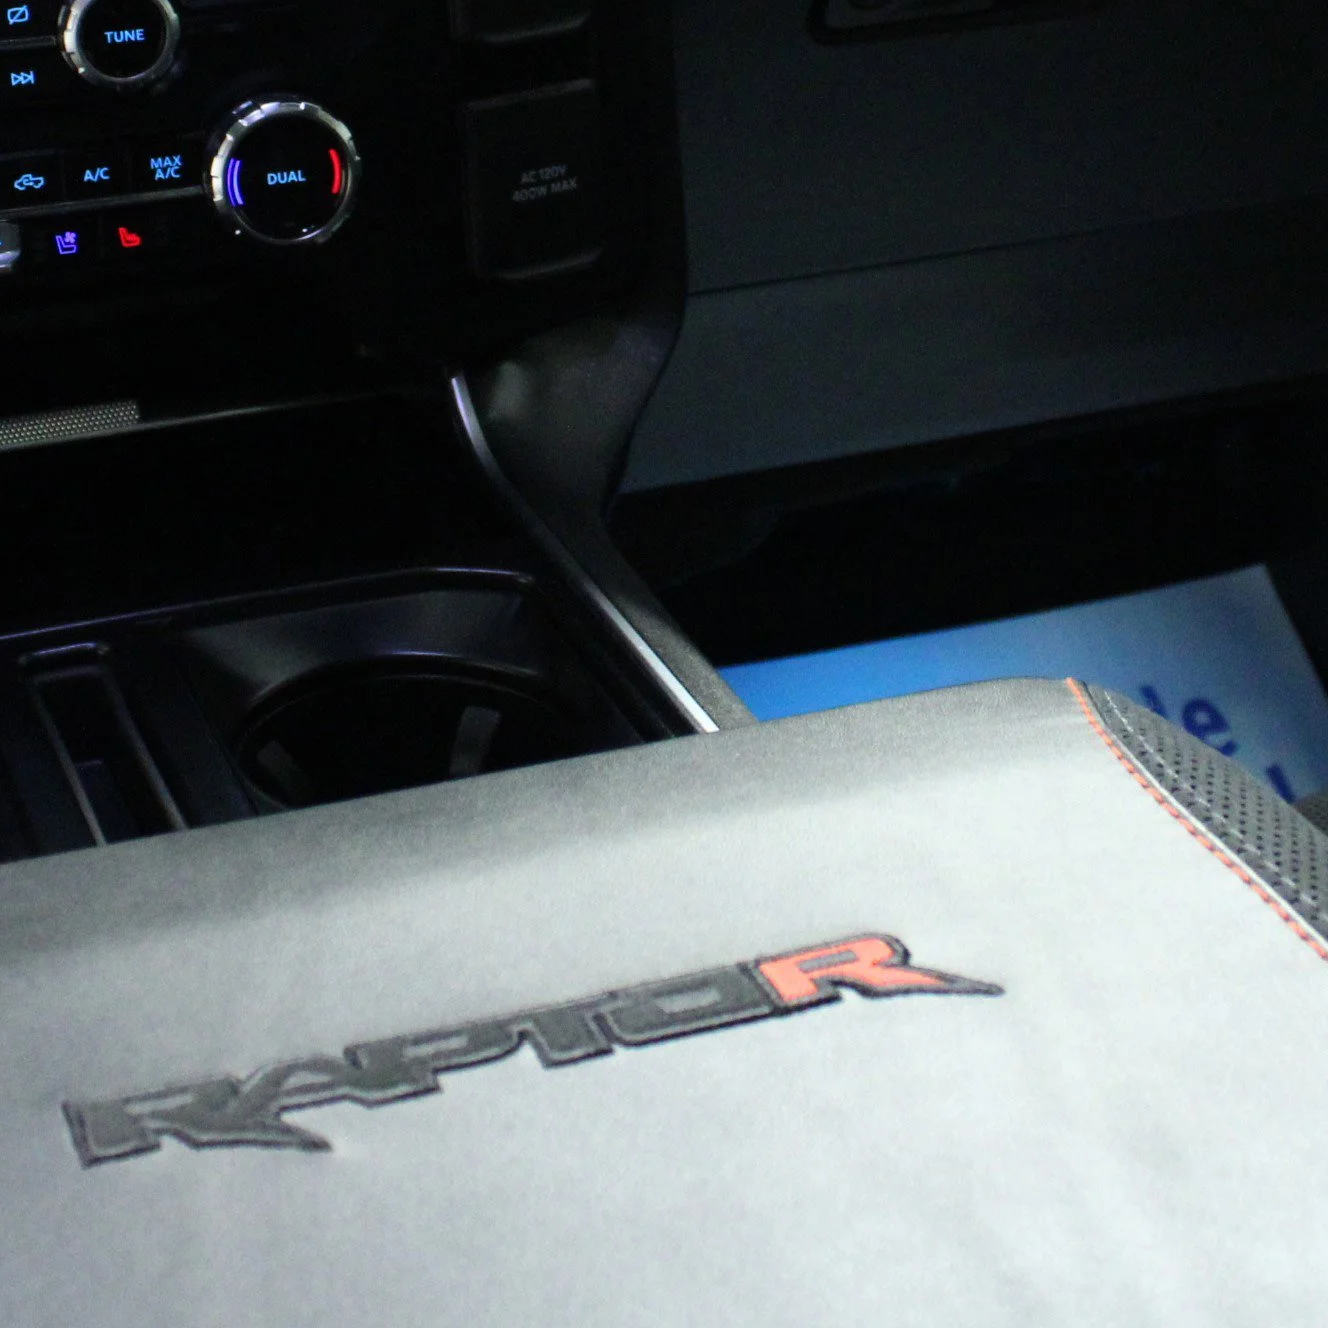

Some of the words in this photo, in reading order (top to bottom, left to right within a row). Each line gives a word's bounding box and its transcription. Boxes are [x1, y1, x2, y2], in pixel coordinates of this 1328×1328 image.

[104, 28, 146, 44] TUNE
[150, 154, 182, 169] MAX
[83, 166, 110, 182] A/C
[154, 165, 181, 180] A/C
[266, 170, 306, 186] DUAL
[64, 932, 1004, 1169] RAPTOR
